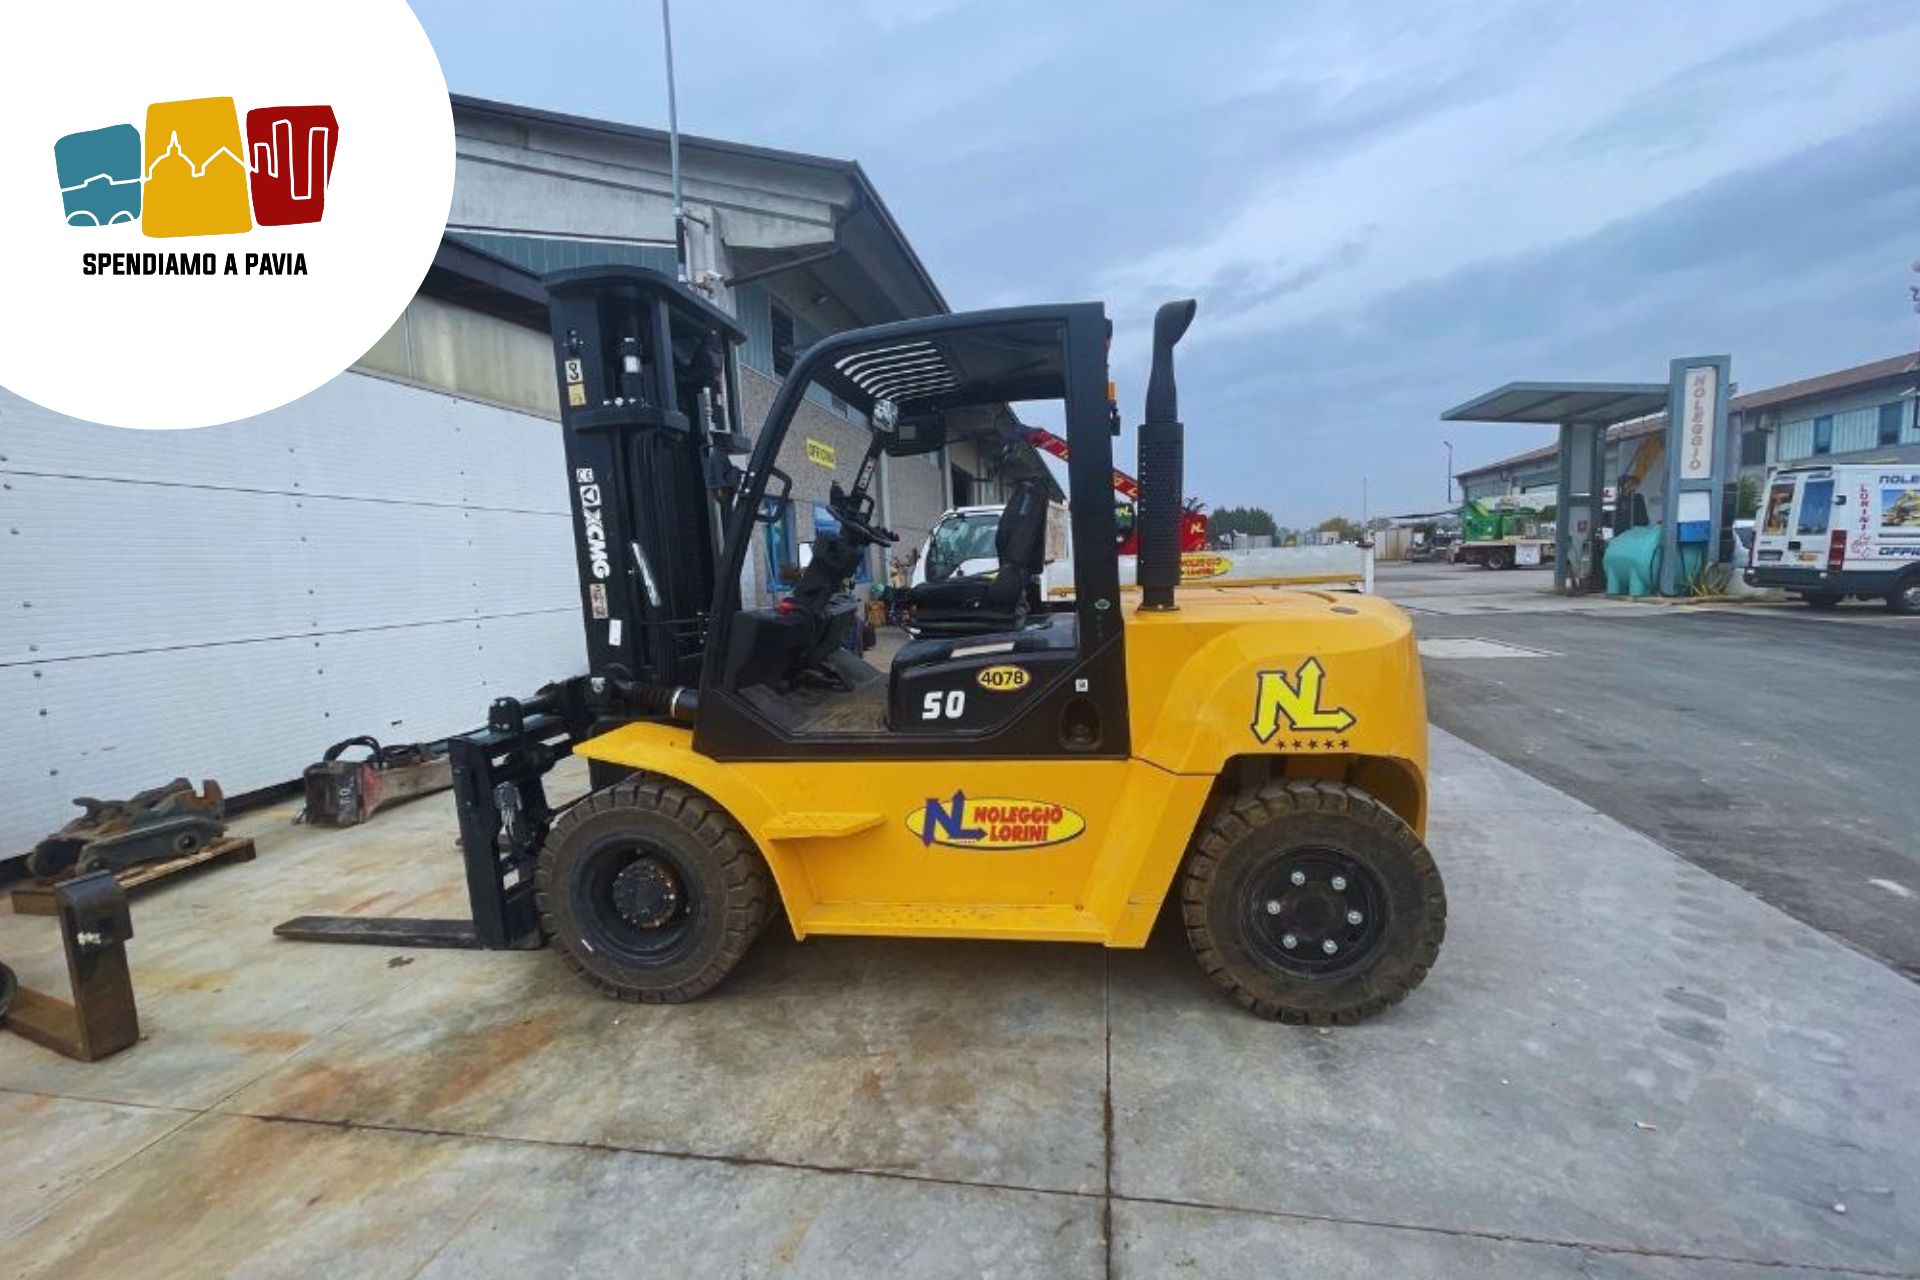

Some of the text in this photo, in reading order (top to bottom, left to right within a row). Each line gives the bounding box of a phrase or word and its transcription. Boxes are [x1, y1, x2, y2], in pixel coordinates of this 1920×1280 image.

[584, 508, 610, 578] XCMG
[981, 671, 1024, 685] 4078
[922, 691, 965, 719] 50
[1251, 656, 1357, 744] NL
[974, 805, 1063, 824] NOLEGGIO
[989, 825, 1049, 842] LORINI
